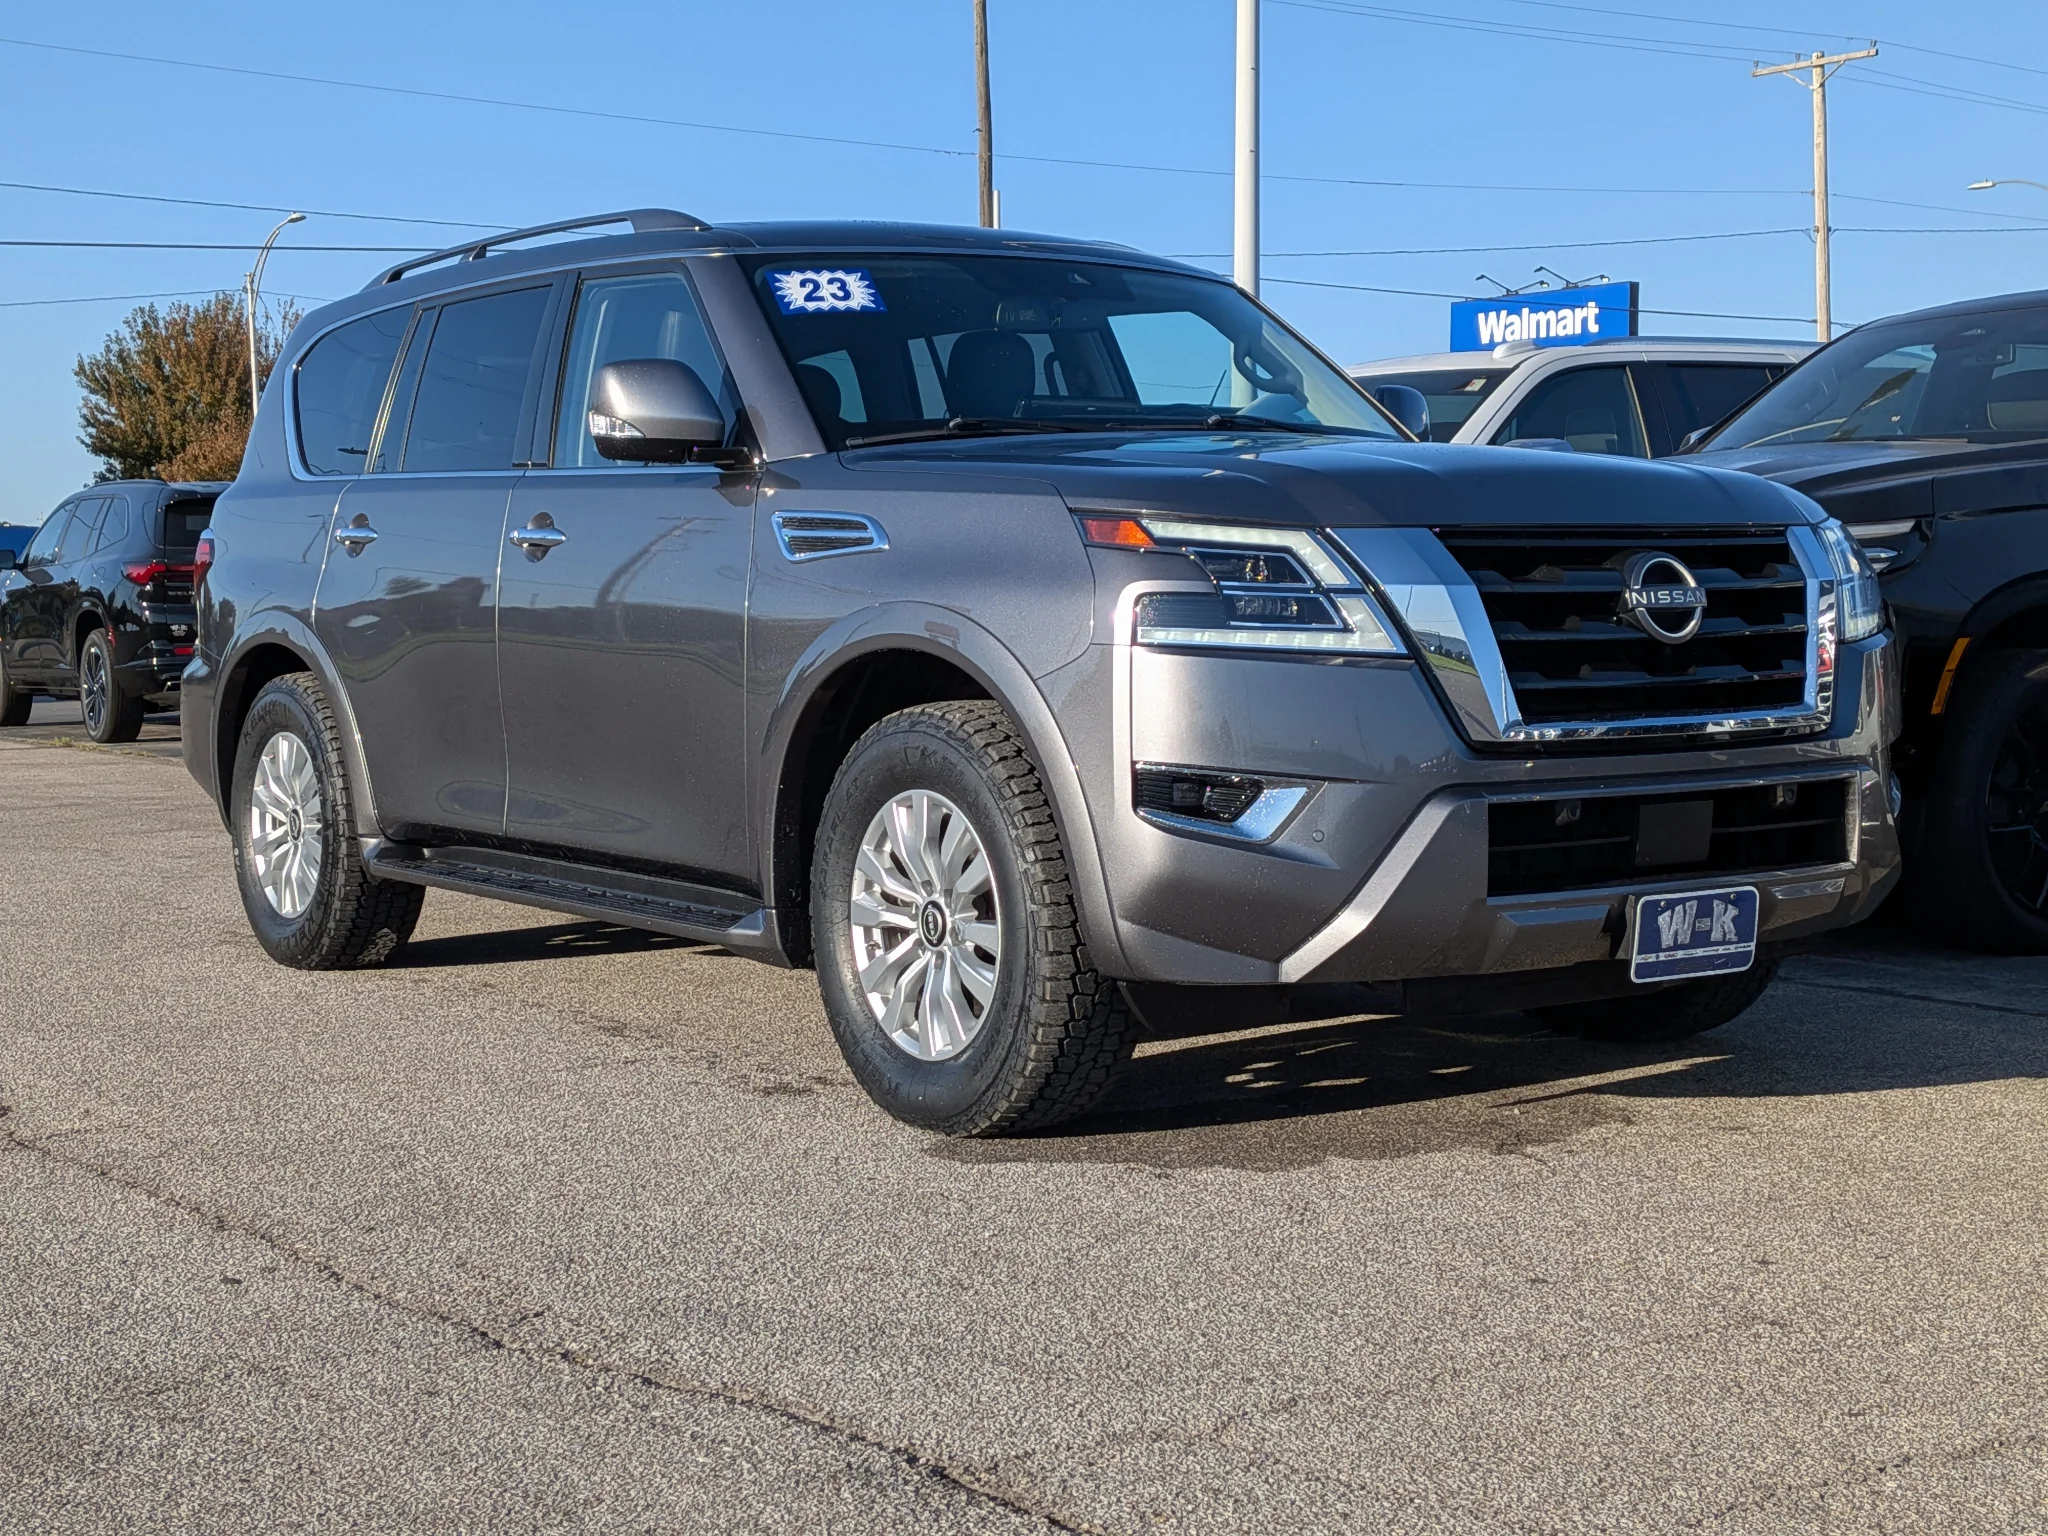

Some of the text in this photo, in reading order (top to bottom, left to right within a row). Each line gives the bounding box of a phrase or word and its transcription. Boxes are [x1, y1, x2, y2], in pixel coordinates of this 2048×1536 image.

[799, 277, 852, 303] 23
[1477, 301, 1600, 345] Walmart
[1631, 590, 1706, 605] NISSAN
